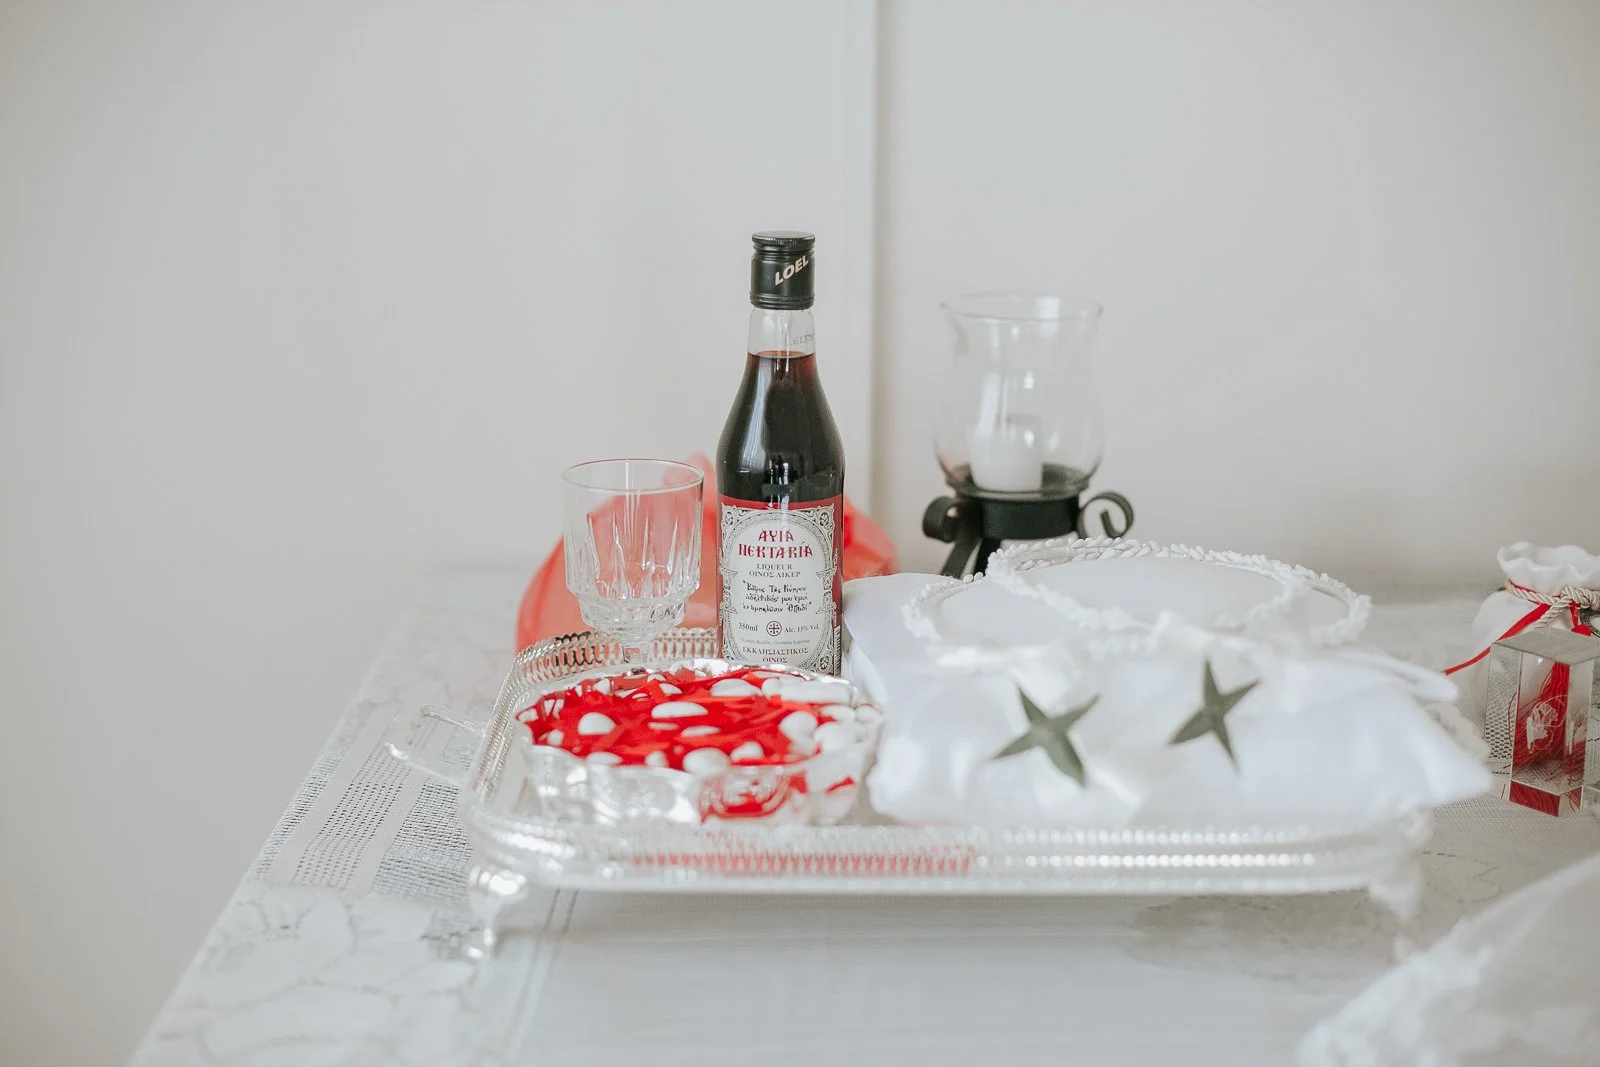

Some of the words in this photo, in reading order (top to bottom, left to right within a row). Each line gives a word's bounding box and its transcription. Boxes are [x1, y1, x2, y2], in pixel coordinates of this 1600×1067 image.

[775, 255, 809, 286] LOEL
[757, 563, 792, 571] LIQUEUR
[739, 623, 758, 632] 350ml
